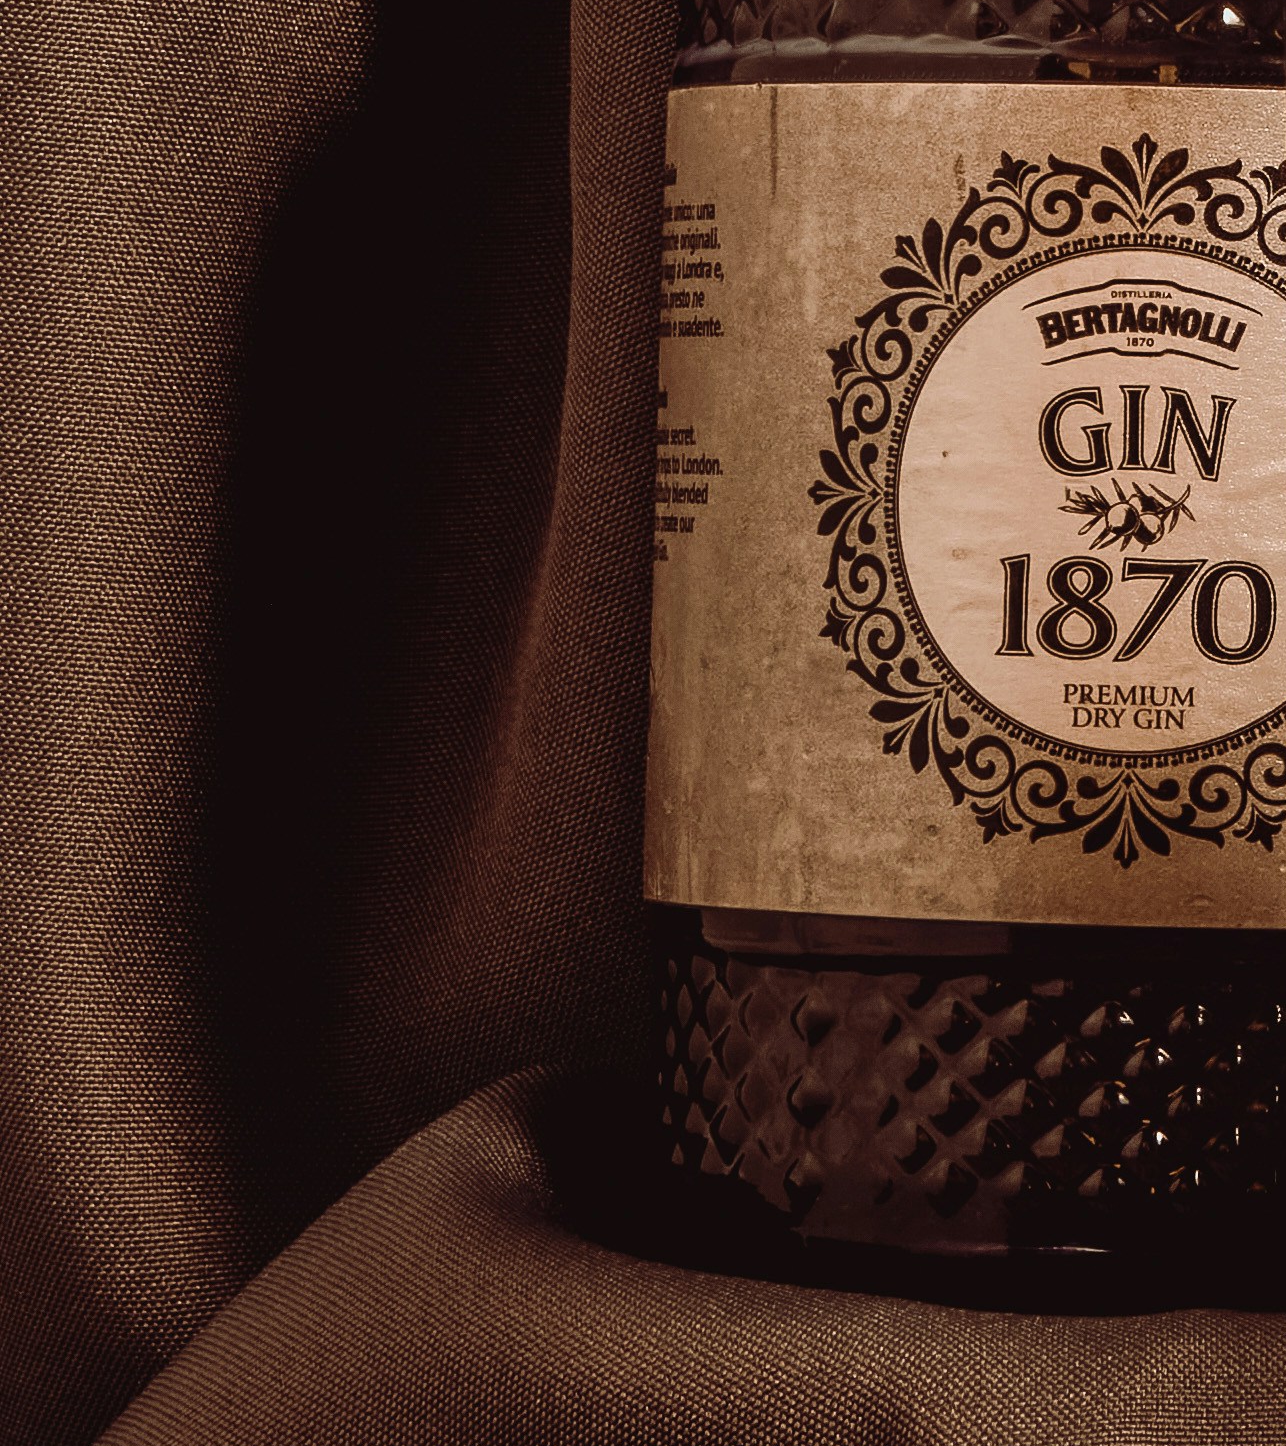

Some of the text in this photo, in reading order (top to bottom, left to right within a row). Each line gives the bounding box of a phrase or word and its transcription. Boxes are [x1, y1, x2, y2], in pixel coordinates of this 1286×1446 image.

[682, 257, 713, 280] Londra
[714, 262, 725, 283] e,
[691, 292, 706, 309] ne
[1110, 290, 1173, 299] DISTILLERIA
[678, 315, 725, 338] suadente.
[1036, 303, 1248, 353] BERTAGNOLLI
[1126, 337, 1155, 347] 1870
[1038, 384, 1238, 482] GIN
[682, 453, 724, 476] London.
[672, 482, 709, 505] blended
[679, 517, 695, 533] our
[995, 553, 1278, 665] 1870
[1063, 683, 1195, 708] PREMIUM
[1072, 707, 1186, 730] DRY GIN
